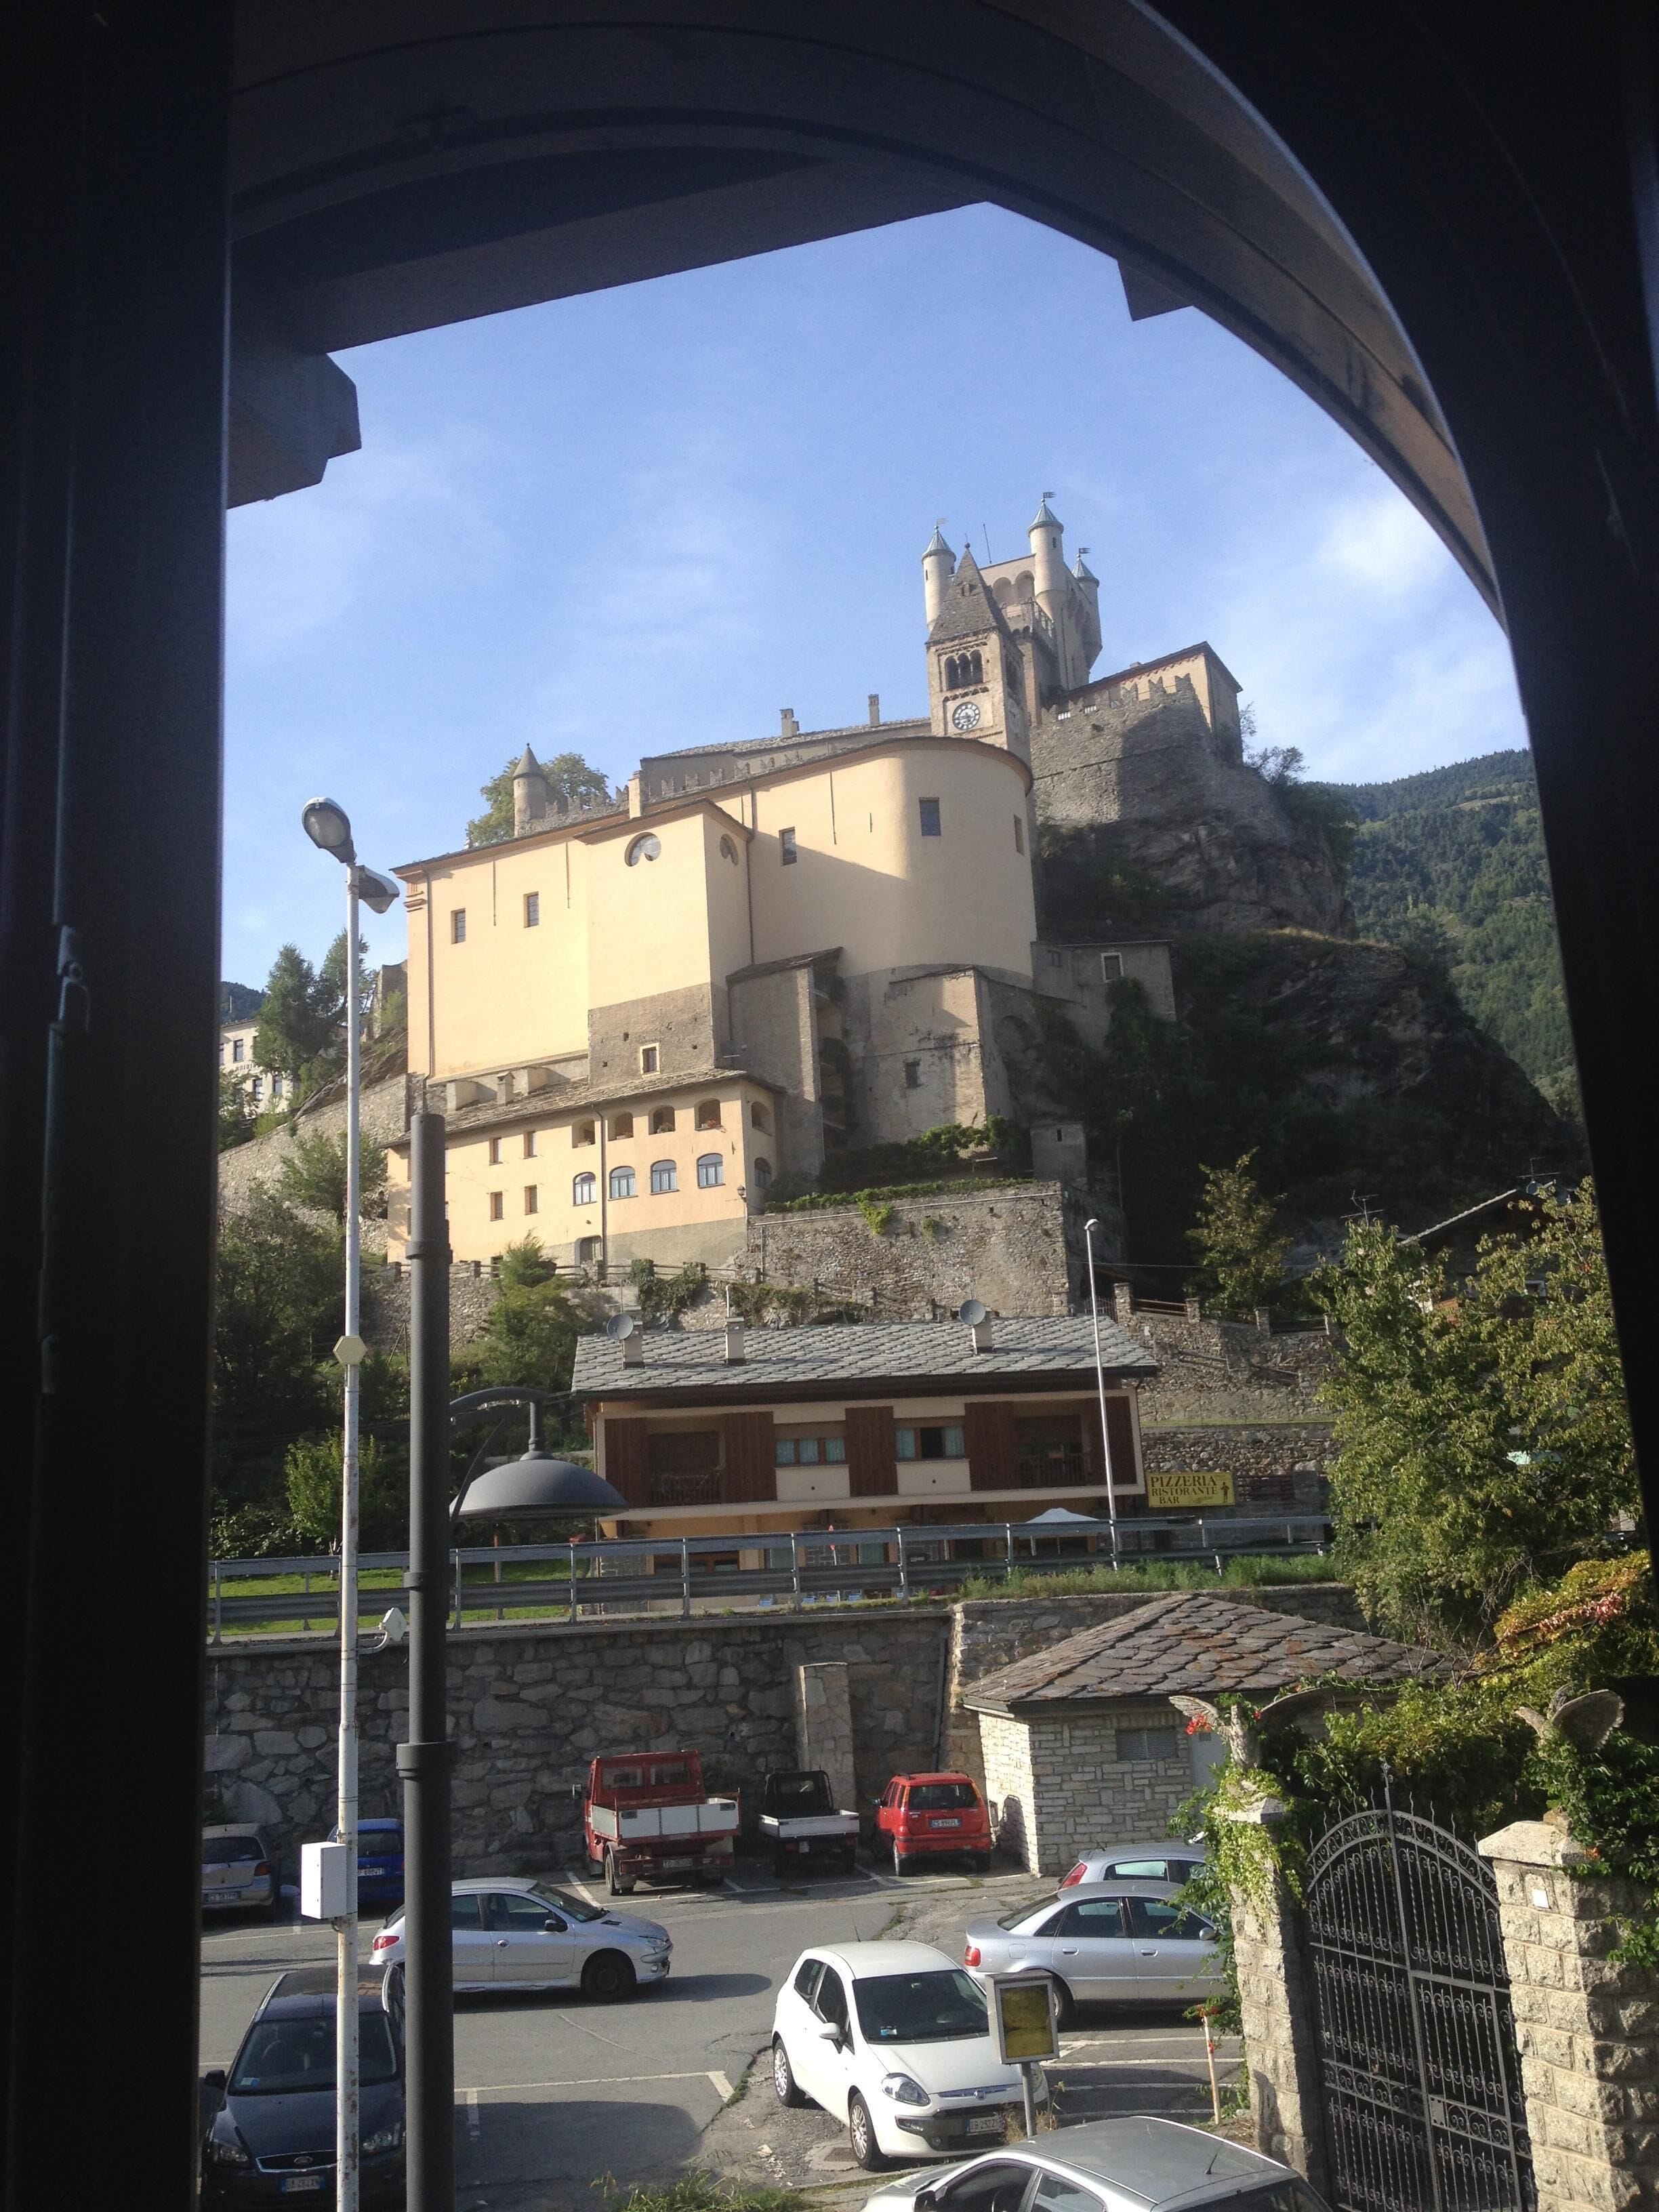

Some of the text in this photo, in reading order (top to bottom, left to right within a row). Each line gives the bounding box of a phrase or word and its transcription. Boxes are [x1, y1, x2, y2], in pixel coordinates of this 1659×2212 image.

[1151, 1475, 1217, 1488] PIZZERIA
[1151, 1487, 1217, 1496] RISTORANTE
[1159, 1496, 1180, 1504] BAR
